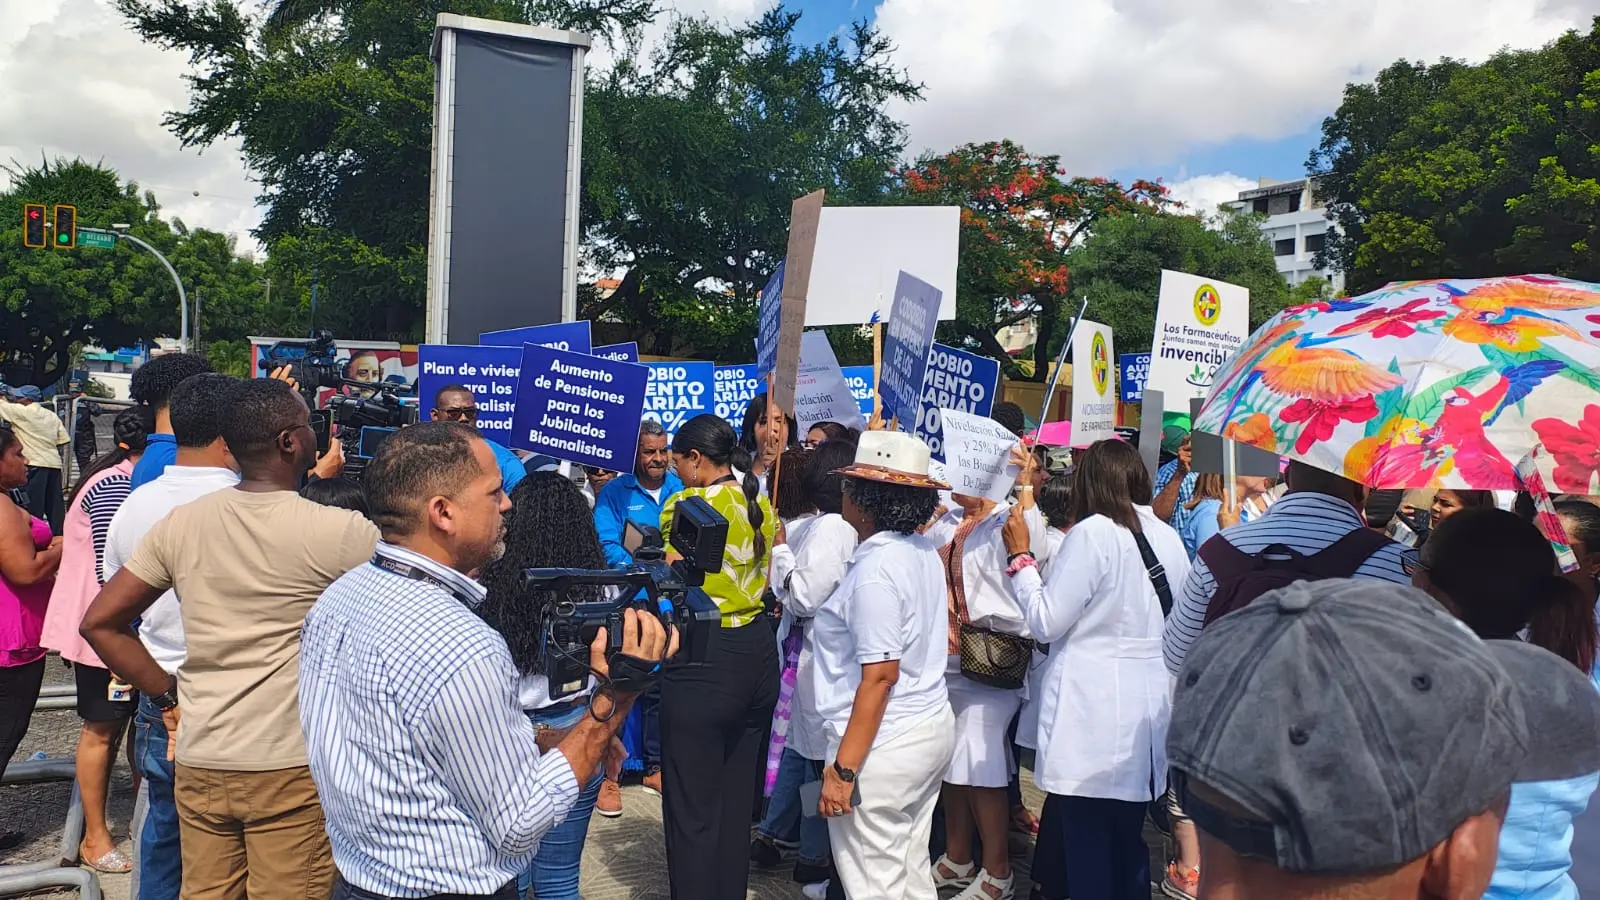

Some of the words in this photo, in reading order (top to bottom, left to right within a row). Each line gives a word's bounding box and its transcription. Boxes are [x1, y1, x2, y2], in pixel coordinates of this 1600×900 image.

[1163, 323, 1180, 334] Los
[1162, 334, 1185, 344] Juntos
[1160, 342, 1227, 366] invencibl
[423, 361, 455, 375] Plan
[458, 362, 477, 376] de
[550, 359, 614, 383] Aumento
[902, 350, 914, 378] LOS
[714, 369, 746, 381] OBIO
[491, 381, 513, 395] los
[534, 374, 552, 389] de
[555, 378, 625, 405] Pensiones
[714, 378, 760, 392] ENTO
[547, 399, 581, 415] para
[583, 403, 605, 420] los
[475, 416, 513, 430] onad
[540, 413, 607, 439] Jubilados
[945, 416, 994, 437] Nivelación
[528, 429, 614, 460] Bioanalistas
[972, 439, 993, 454] 25%
[957, 455, 971, 468] las
